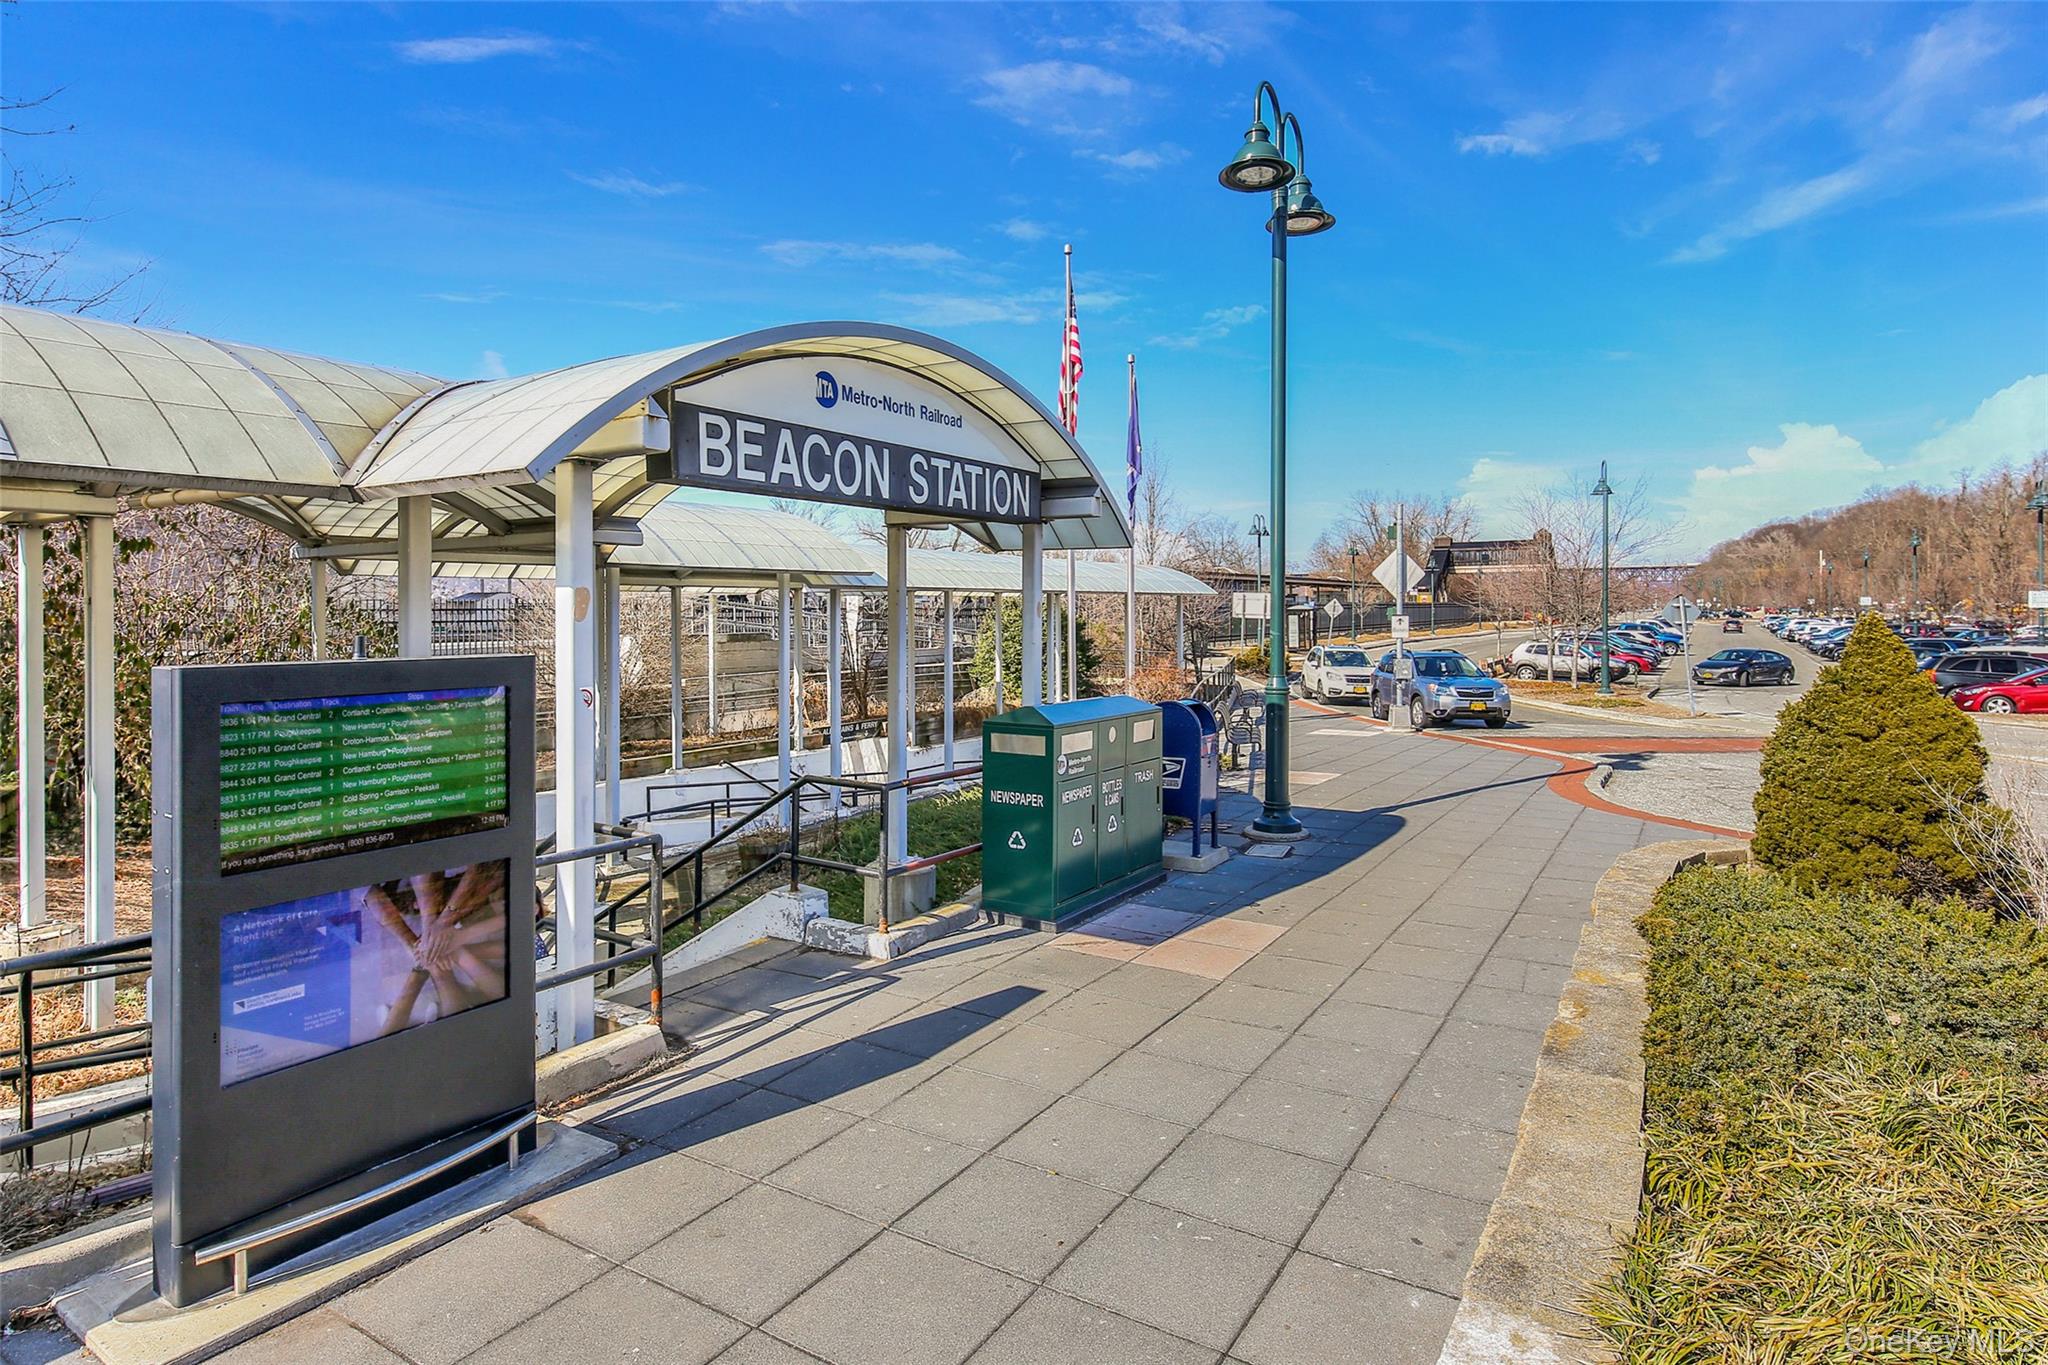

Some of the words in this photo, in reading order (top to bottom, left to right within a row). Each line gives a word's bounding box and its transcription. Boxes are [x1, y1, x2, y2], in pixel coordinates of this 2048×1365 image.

[816, 375, 835, 402] MTA
[841, 387, 915, 418] Metro-North
[920, 406, 963, 429] Railroad
[698, 412, 890, 500] BEACON
[908, 452, 1030, 517] STATION
[274, 700, 312, 709] Destination
[322, 698, 339, 706] Track
[275, 714, 296, 722] Grand
[297, 712, 322, 720] Central
[861, 722, 878, 730] FERRY
[275, 728, 322, 738] Poughkeepsie
[358, 722, 386, 731] Hamburg
[258, 746, 270, 754] PM
[275, 744, 296, 752] Grand
[297, 742, 322, 750] Central
[275, 758, 322, 768] Poughkeepsie
[343, 752, 357, 760] New
[359, 750, 387, 759] Hamburg
[275, 774, 296, 782] Grand
[297, 771, 322, 780] Central
[377, 760, 421, 770] Croton-Harmon
[1134, 769, 1154, 783] TRASH
[258, 791, 270, 799] PM
[275, 786, 322, 797] Poughkeepsie
[343, 780, 357, 788] New
[359, 778, 387, 787] Hamburg
[1061, 785, 1093, 805] NEWSPAPER
[1102, 778, 1123, 794] BOTTLES
[258, 806, 270, 814] PM
[275, 803, 296, 812] Grand
[297, 800, 322, 809] Central
[343, 794, 358, 802] Cold
[359, 792, 379, 801] Spring
[990, 790, 1044, 808] NEWSPAPER
[1109, 793, 1120, 805] CANS
[275, 818, 296, 827] Grand
[297, 814, 322, 824] Central
[343, 809, 358, 817] Cold
[360, 806, 379, 815] Spring
[258, 837, 270, 845] PM
[275, 830, 322, 842] Poughkeepsie
[343, 823, 357, 831] New
[359, 819, 387, 829] Hamburg
[228, 859, 241, 869] you
[244, 857, 256, 865] see
[244, 915, 284, 930] Network
[234, 932, 259, 946] Right
[262, 927, 284, 938] Here
